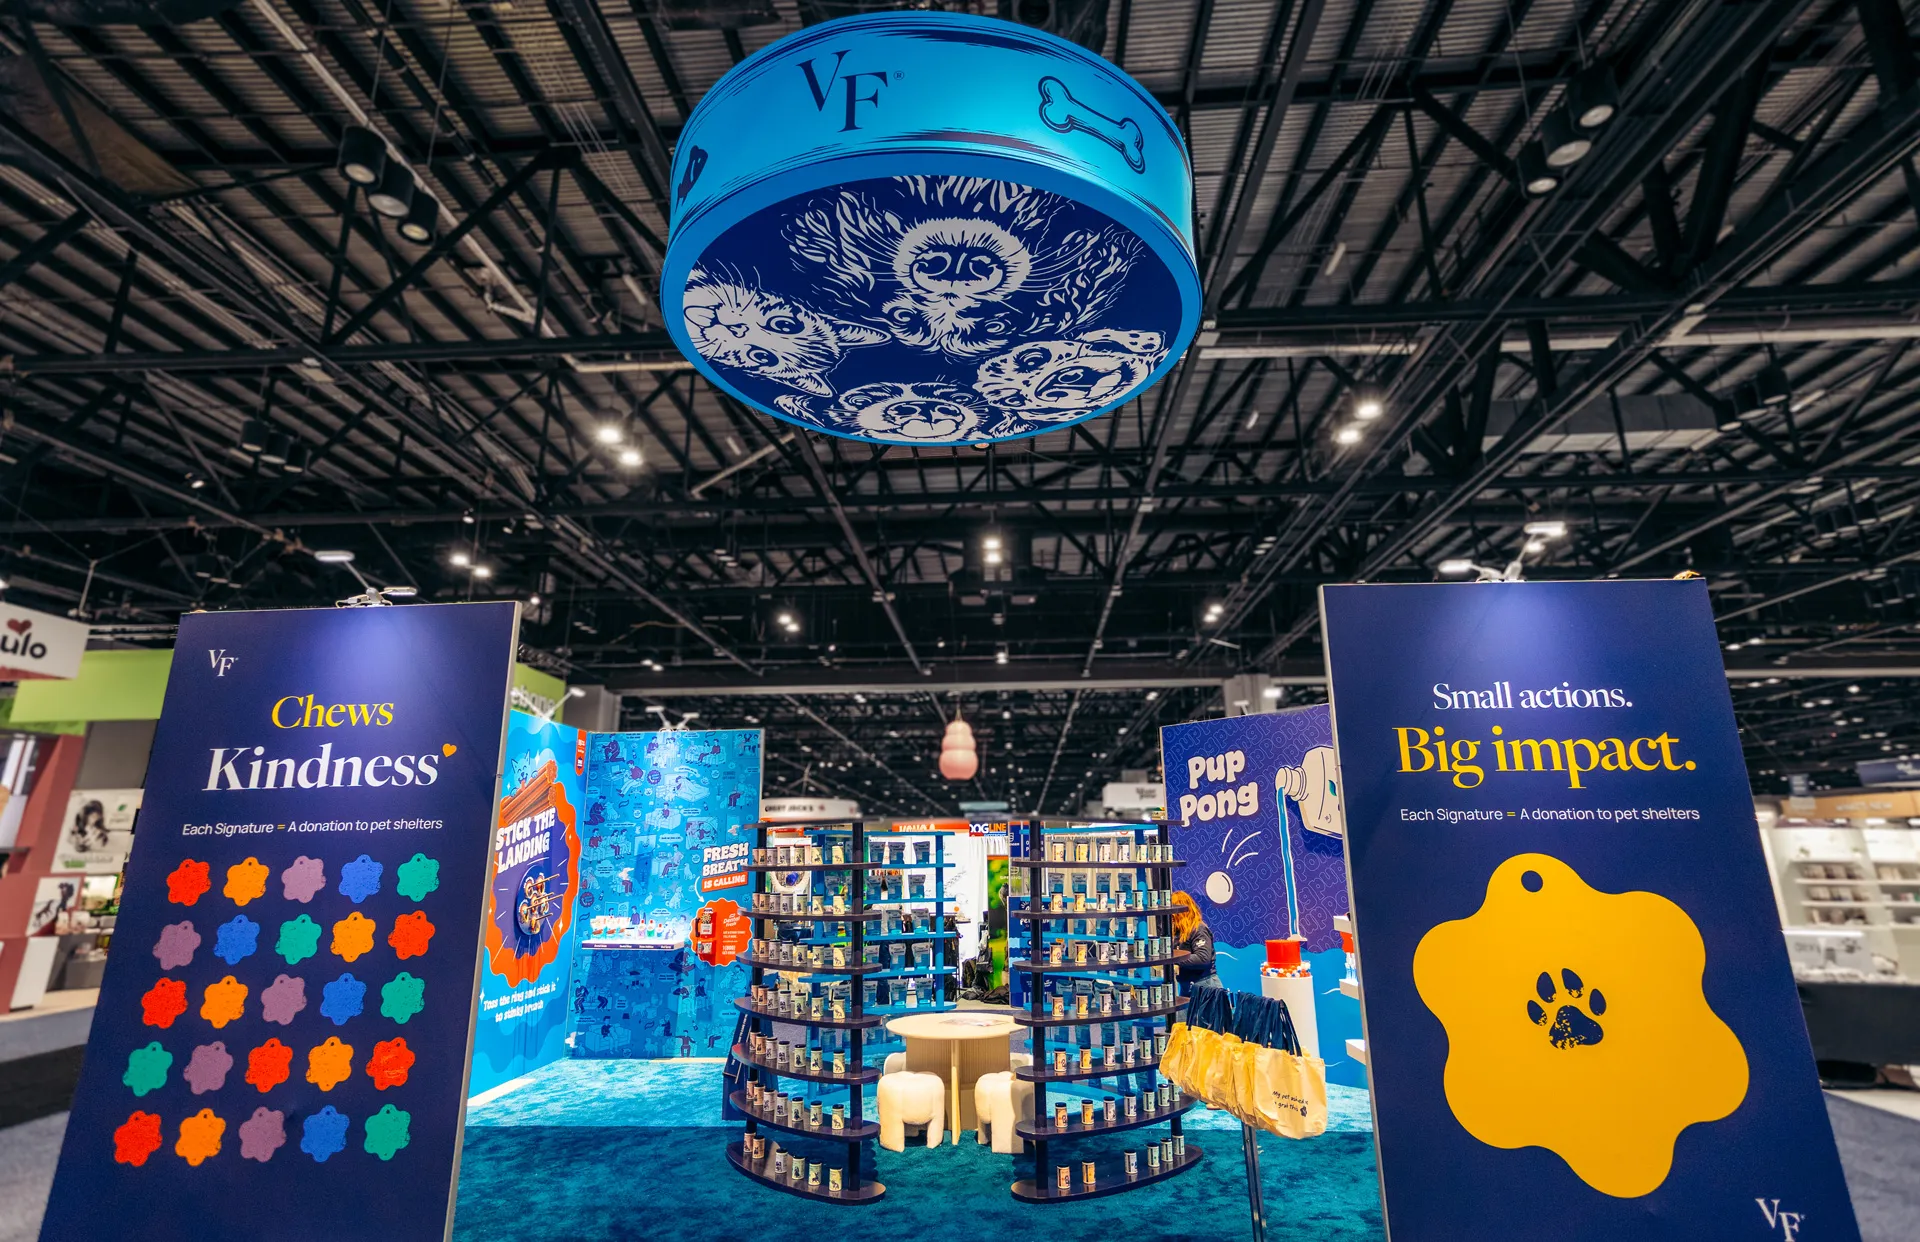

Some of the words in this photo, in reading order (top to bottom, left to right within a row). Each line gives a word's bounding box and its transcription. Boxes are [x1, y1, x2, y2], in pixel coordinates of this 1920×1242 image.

[271, 694, 394, 729] Chews
[1433, 681, 1514, 710] Small
[1519, 681, 1633, 709] actions.
[202, 742, 439, 791] Kindness
[1392, 725, 1485, 789] Big
[1491, 725, 1697, 789] impact.
[182, 823, 213, 836] Each
[214, 822, 275, 838] Signature
[287, 821, 297, 832] A
[299, 819, 353, 833] donation
[355, 820, 368, 831] to
[370, 819, 392, 833] pet
[393, 818, 443, 830] shelters
[495, 816, 532, 851] STICK
[534, 807, 556, 834] THE
[1400, 808, 1434, 821] Each
[1436, 808, 1503, 824] Signature
[1520, 808, 1530, 820] A
[1532, 807, 1595, 820] donation
[1596, 808, 1612, 820] to
[1614, 808, 1639, 823] pet
[1641, 807, 1700, 820] shelters
[497, 832, 551, 874] LANDING
[703, 842, 749, 863] FRESH
[704, 880, 713, 889] IS
[713, 875, 746, 887] CALLING
